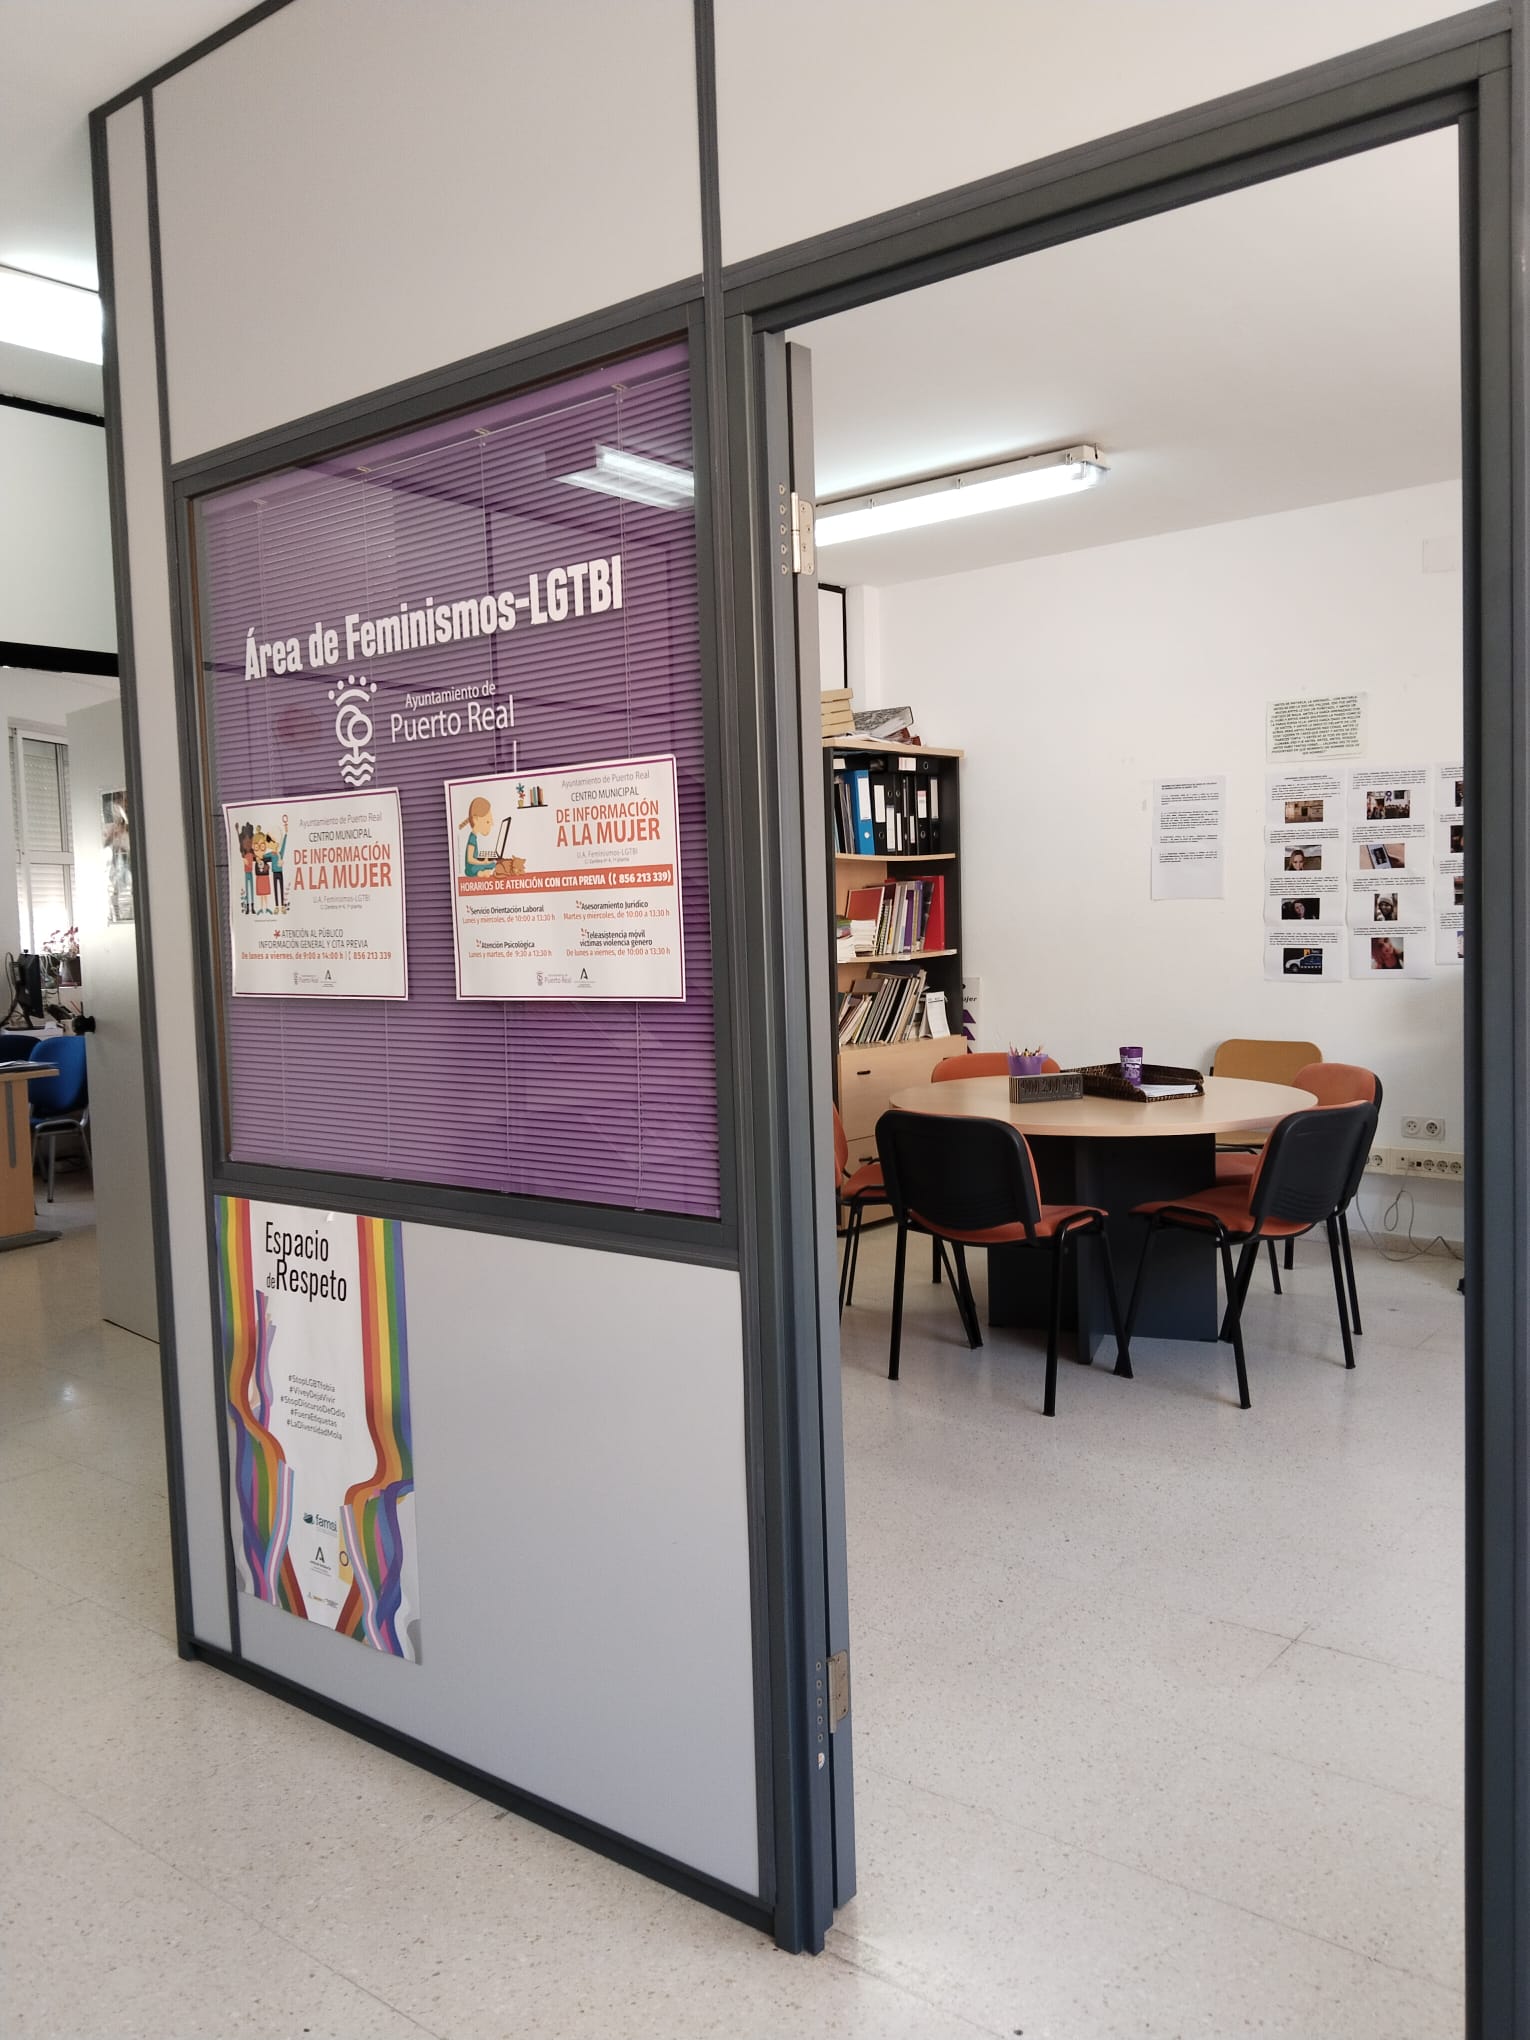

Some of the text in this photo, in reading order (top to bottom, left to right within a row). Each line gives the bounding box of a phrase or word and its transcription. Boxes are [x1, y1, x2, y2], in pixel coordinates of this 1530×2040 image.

[244, 555, 623, 681] Área de Feminismos-LGTBI
[405, 680, 496, 709] Ayuntamiento de
[390, 695, 515, 744] Puerto Real
[562, 770, 650, 789] Ayuntamiento de Puerto Real
[570, 786, 639, 802] CENTRO MUNICIPAL
[347, 814, 367, 824] Puerto
[368, 811, 383, 821] Real
[556, 797, 659, 824] DE INFORMACIÓN
[308, 828, 373, 843] CENTRO MUNICIPAL
[557, 817, 661, 848] A LA MUJER
[293, 841, 391, 865] DE INFORMACIÓN
[293, 862, 392, 890] A LA MUJER
[460, 881, 494, 892] HORARIOS
[495, 880, 505, 890] DE
[505, 876, 543, 889] ATENCIÓN
[544, 877, 560, 887] CON
[561, 876, 578, 887] CITA
[578, 874, 606, 886] PREVIA
[619, 873, 635, 884] 856
[636, 872, 651, 882] 213
[652, 870, 671, 883] 339)
[471, 907, 490, 915] Servicio
[522, 905, 544, 913] Laboral
[581, 901, 624, 910] Asesoramiento
[506, 914, 513, 922] de
[617, 910, 624, 918] de
[625, 910, 642, 918] 10:00
[649, 909, 664, 917] 13:30
[282, 928, 343, 938] ATENCIÓN AL PÚBLICO
[587, 929, 645, 939] Teleasistencia móvil
[300, 940, 326, 948] GENERAL
[332, 940, 345, 948] CITA
[346, 939, 368, 948] PREVIA
[603, 938, 630, 946] violencia
[295, 952, 302, 960] de
[353, 952, 366, 960] 856
[367, 952, 378, 960] 213
[380, 952, 392, 960] 339
[506, 950, 512, 958] de
[566, 949, 574, 957] De
[617, 947, 625, 955] de
[627, 947, 644, 956] 10:00
[649, 947, 666, 955] 13:30
[266, 1221, 329, 1261] Espacio
[266, 1259, 347, 1302] de Respeto
